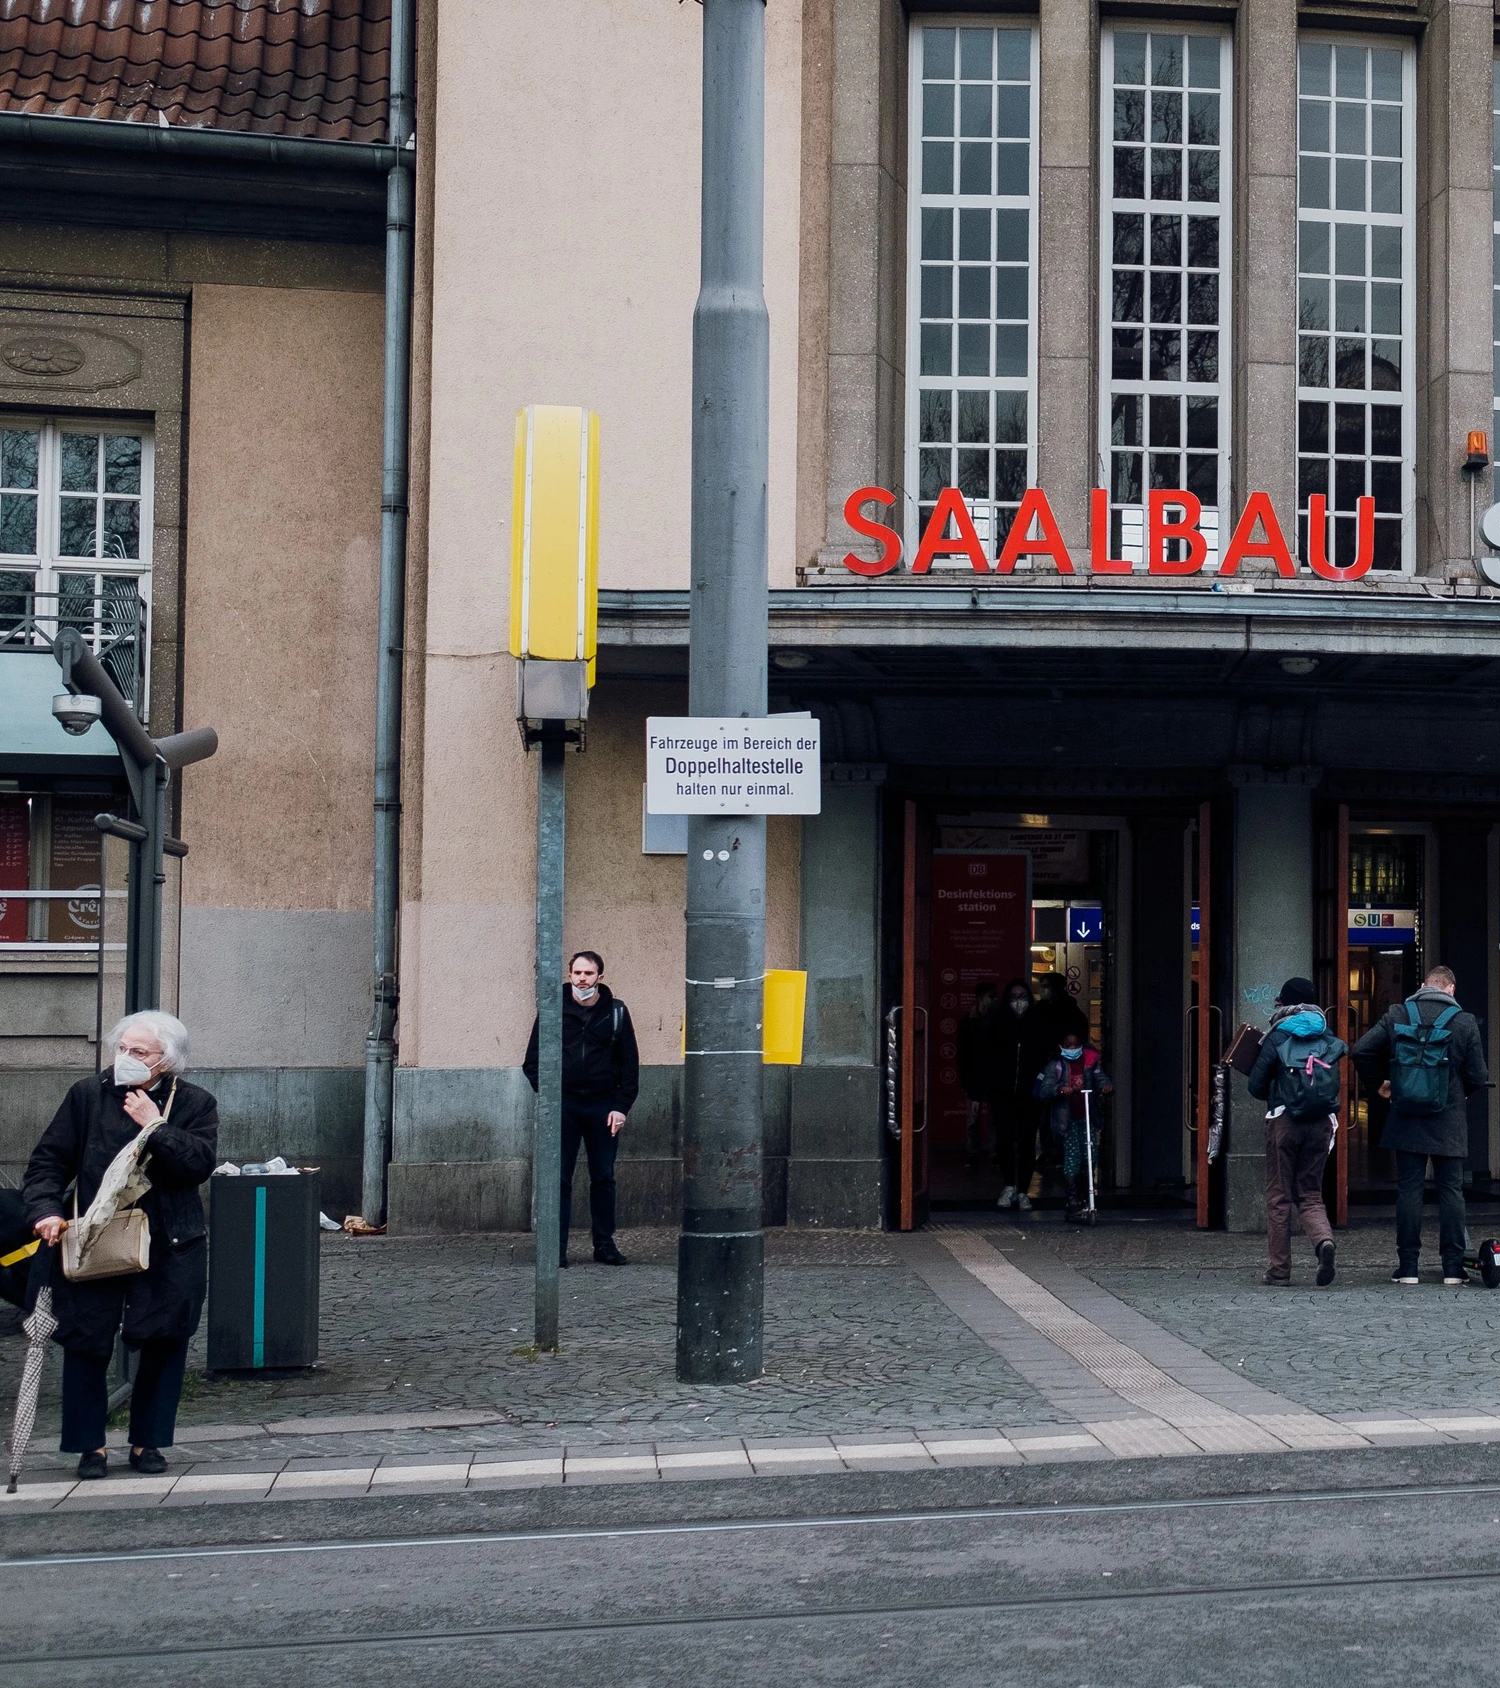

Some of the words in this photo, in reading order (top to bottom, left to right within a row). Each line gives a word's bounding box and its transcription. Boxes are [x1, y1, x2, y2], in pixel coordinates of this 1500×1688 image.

[842, 486, 1376, 582] SAALBAU
[650, 736, 718, 752] Fahrzeuge
[723, 737, 738, 750] im
[744, 736, 792, 750] Bereich
[796, 737, 817, 750] der
[665, 757, 804, 777] Doppelhaltestelle
[676, 782, 716, 795] halten
[721, 785, 742, 795] nur
[746, 782, 794, 795] einmal.
[970, 864, 985, 874] DB
[937, 888, 1017, 900] Desinfektions-
[958, 902, 997, 912] station
